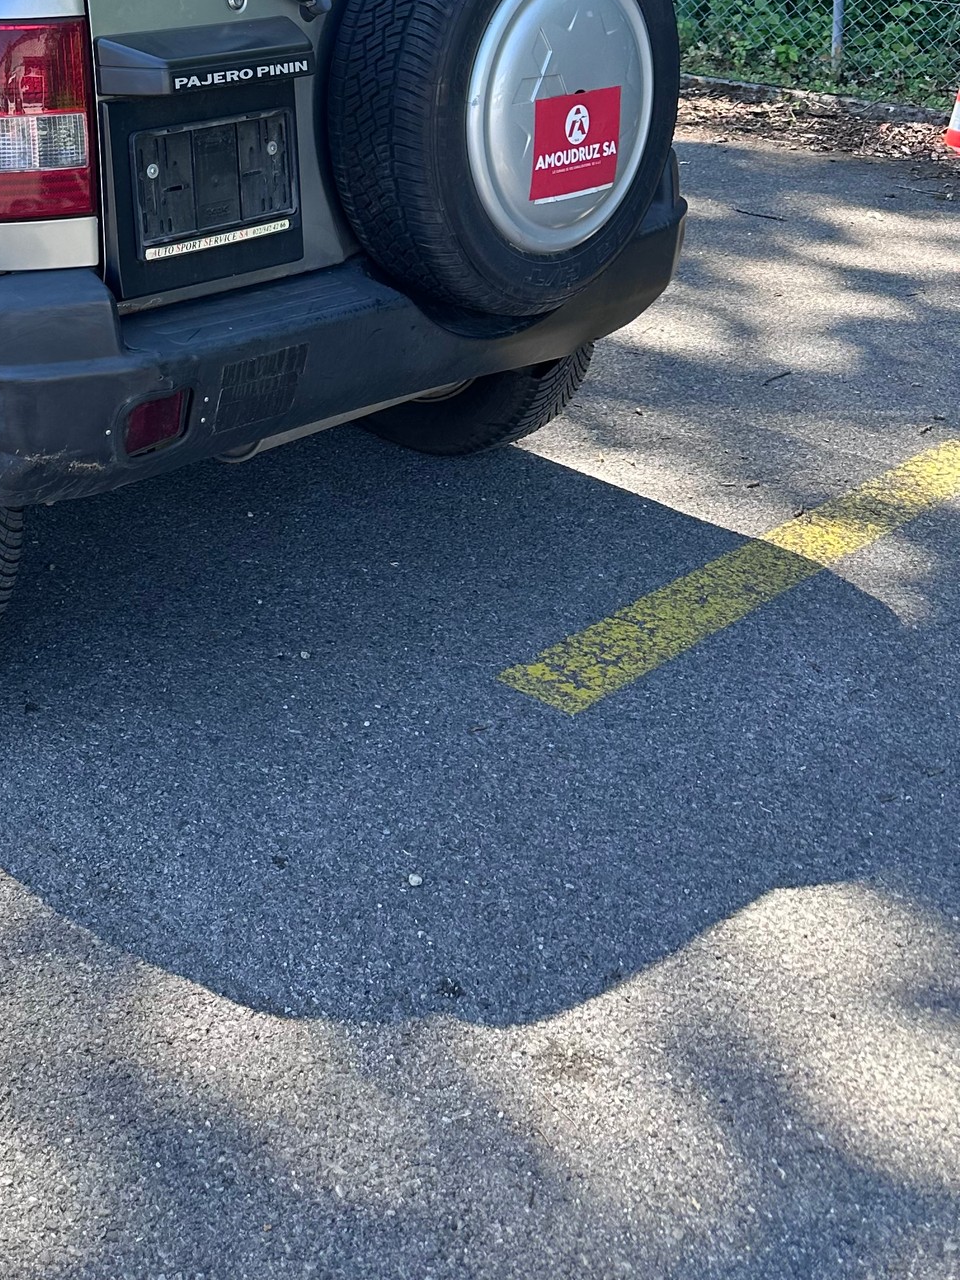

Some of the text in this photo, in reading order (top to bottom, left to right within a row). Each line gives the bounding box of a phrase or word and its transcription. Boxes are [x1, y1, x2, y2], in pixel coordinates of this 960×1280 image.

[174, 60, 308, 90] PAJERO PININ
[534, 143, 601, 171] AMOUDRUZ
[602, 140, 617, 157] SA
[152, 246, 175, 258] AUTO
[175, 240, 203, 253] SPORT
[203, 232, 238, 246] SERVICE
[238, 229, 249, 240] SA
